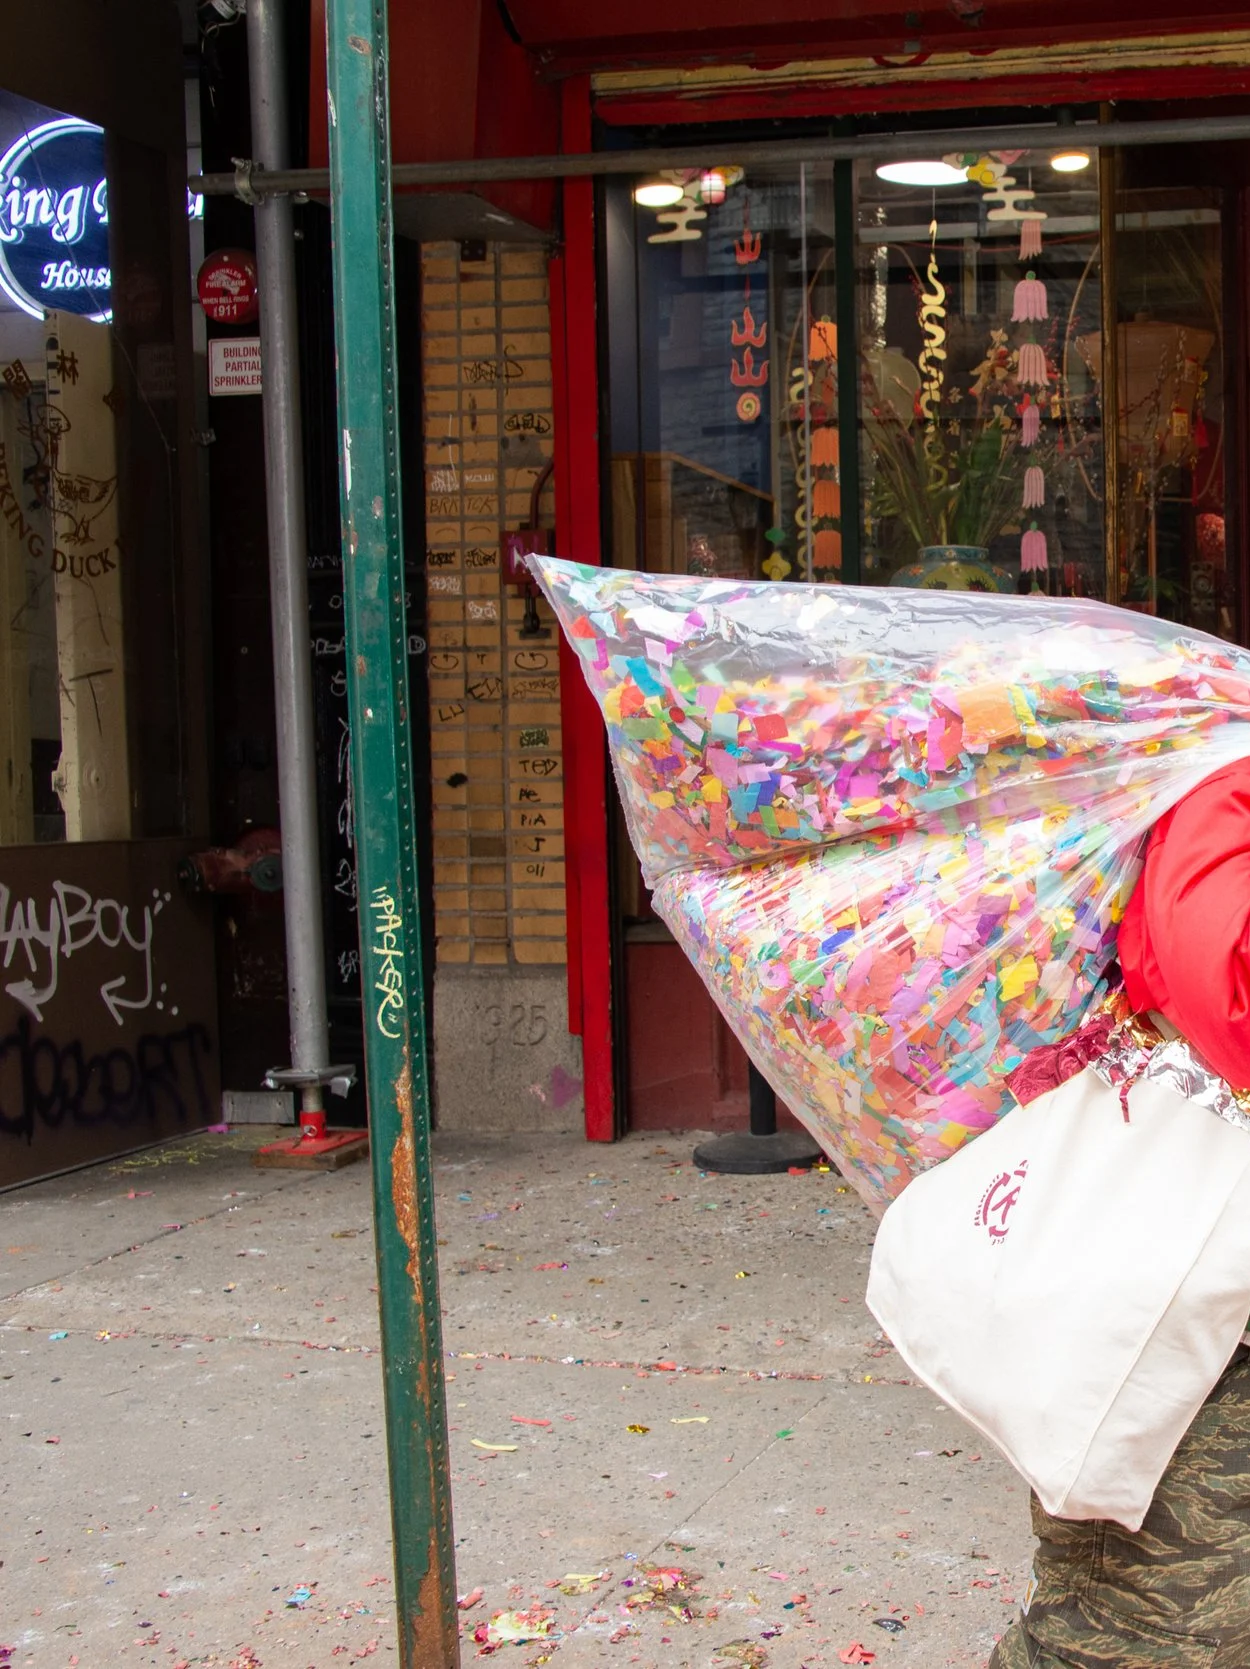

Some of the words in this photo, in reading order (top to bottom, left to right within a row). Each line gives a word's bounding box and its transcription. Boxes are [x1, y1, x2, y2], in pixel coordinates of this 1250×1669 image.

[0, 174, 84, 243] ing
[219, 296, 232, 304] BELL
[218, 304, 237, 317] 911
[225, 360, 261, 372] PARTIAL
[0, 443, 45, 558] KING
[51, 548, 117, 578] DUCK
